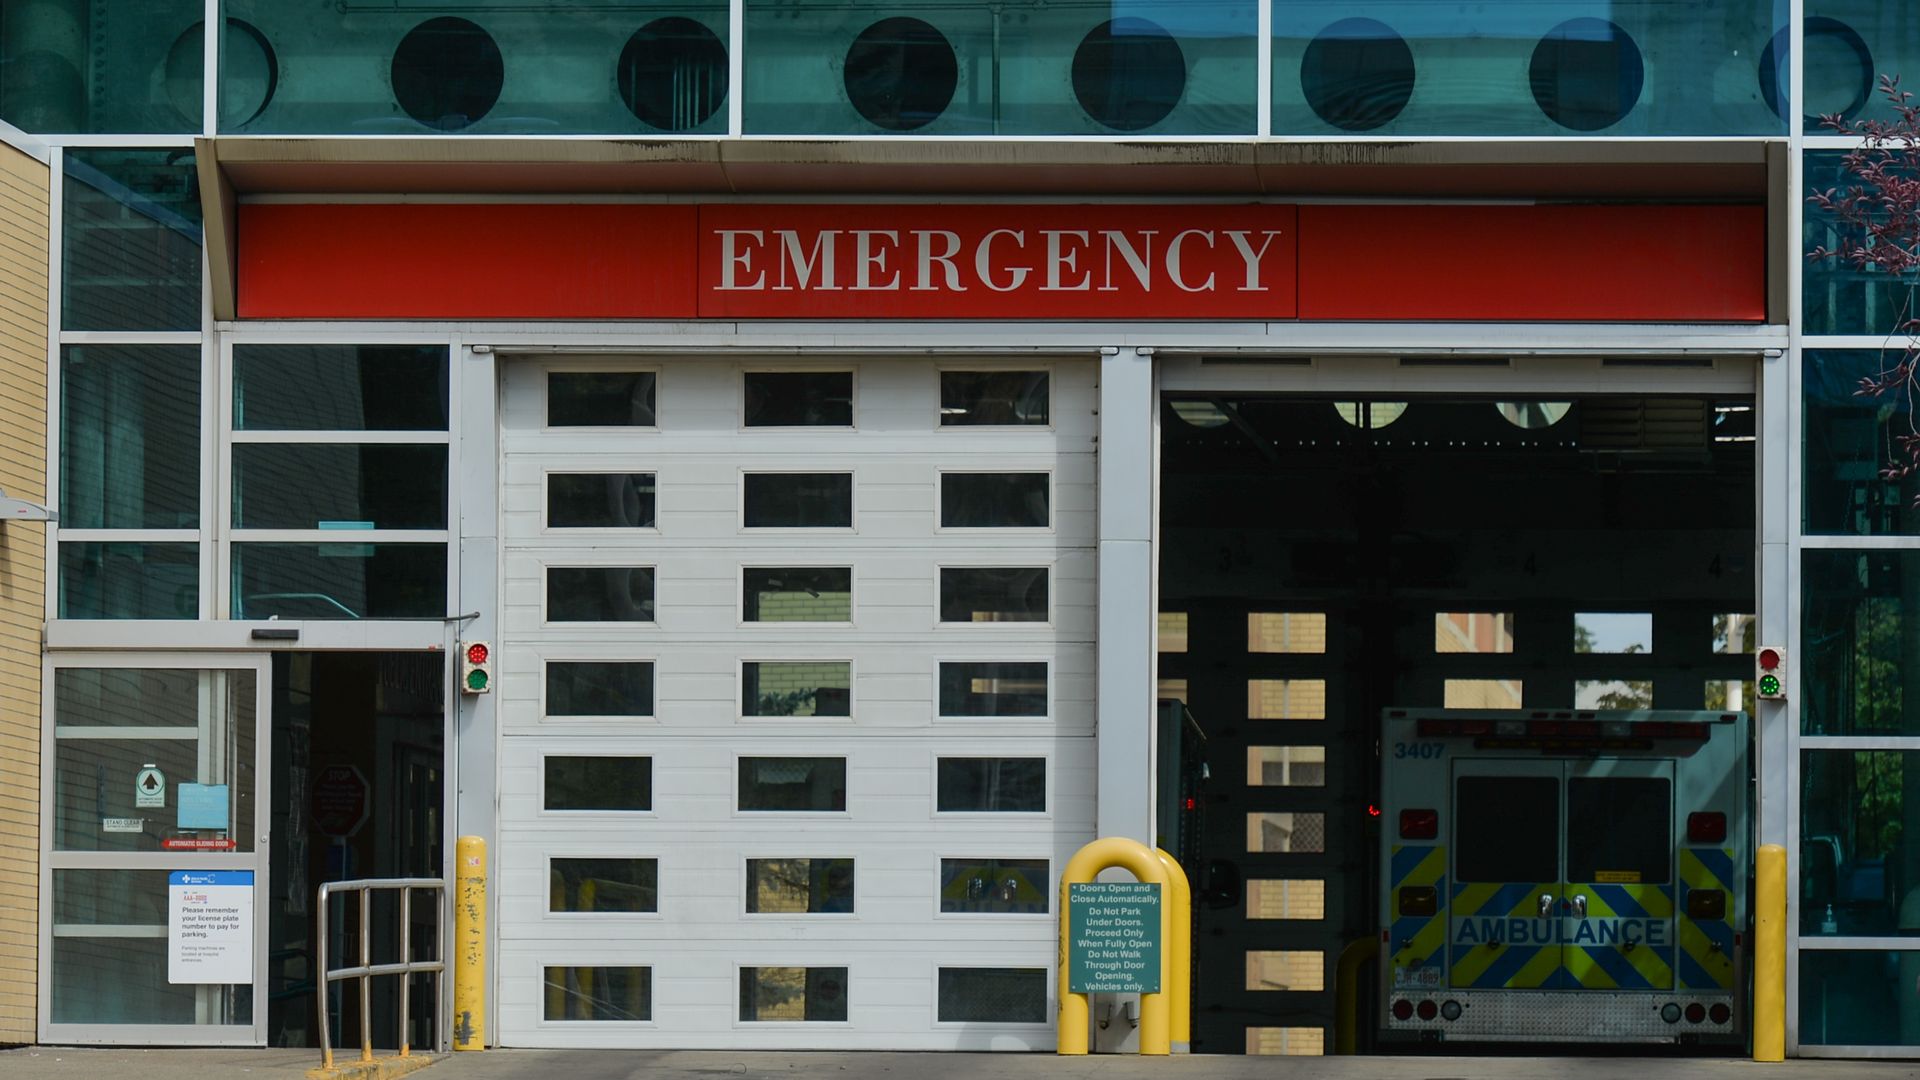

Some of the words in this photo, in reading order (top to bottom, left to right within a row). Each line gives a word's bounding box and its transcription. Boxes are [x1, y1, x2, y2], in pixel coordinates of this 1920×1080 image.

[713, 229, 1282, 293] EMERGENCY
[1524, 552, 1536, 577] 4
[1708, 553, 1721, 578] 4
[1394, 742, 1446, 760] 3407
[328, 770, 352, 781] STOP
[1079, 884, 1106, 893] Doors
[1108, 884, 1132, 894] Open
[1134, 884, 1151, 893] and
[1071, 894, 1096, 903] Close
[1097, 894, 1159, 905] Automatically.
[182, 906, 204, 914] Please
[1088, 907, 1102, 915] Do
[1103, 907, 1119, 915] Not
[1121, 907, 1141, 915] Park
[222, 915, 239, 923] plate
[1086, 917, 1113, 927] Under
[1115, 917, 1144, 927] Doors.
[181, 931, 208, 939] parking.
[1085, 928, 1122, 938] Proceed
[1123, 928, 1144, 938] Only
[1455, 918, 1666, 945] AMBULANCE
[1078, 939, 1103, 948] When
[1105, 939, 1127, 949] Fully
[1128, 939, 1152, 949] Open
[1088, 950, 1101, 958] Do
[1102, 950, 1118, 958] Not
[1119, 950, 1141, 958] Walk
[1085, 961, 1122, 970] Through
[1123, 960, 1145, 969] Door
[1095, 971, 1134, 980] Opening.
[1085, 982, 1122, 991] Vehicles
[1123, 982, 1145, 992] only.
